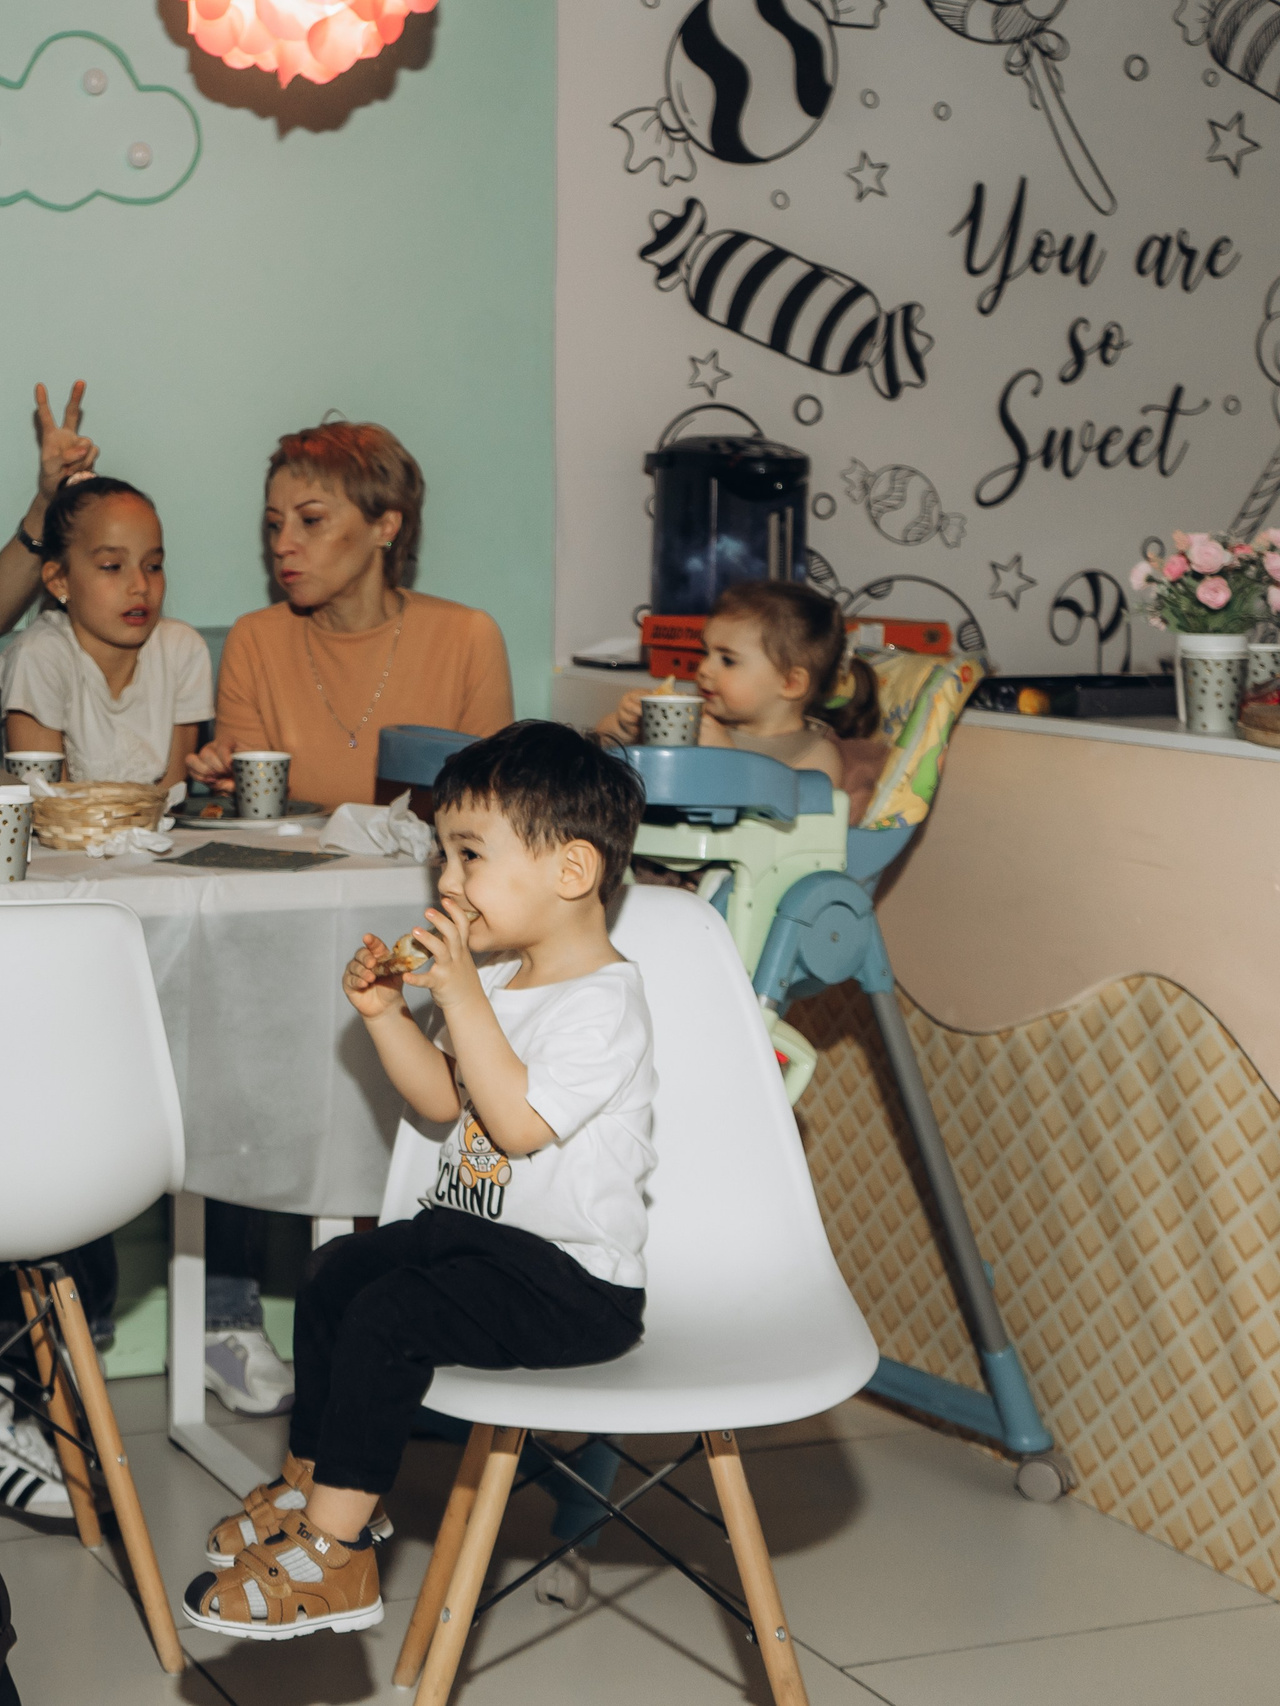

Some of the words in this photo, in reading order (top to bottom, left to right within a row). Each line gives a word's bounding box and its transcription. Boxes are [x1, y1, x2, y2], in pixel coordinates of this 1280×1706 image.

[948, 174, 1107, 315] You
[1134, 227, 1242, 294] are
[1058, 316, 1132, 384] so
[974, 367, 1211, 509] Sweet
[435, 1158, 505, 1219] CHINO
